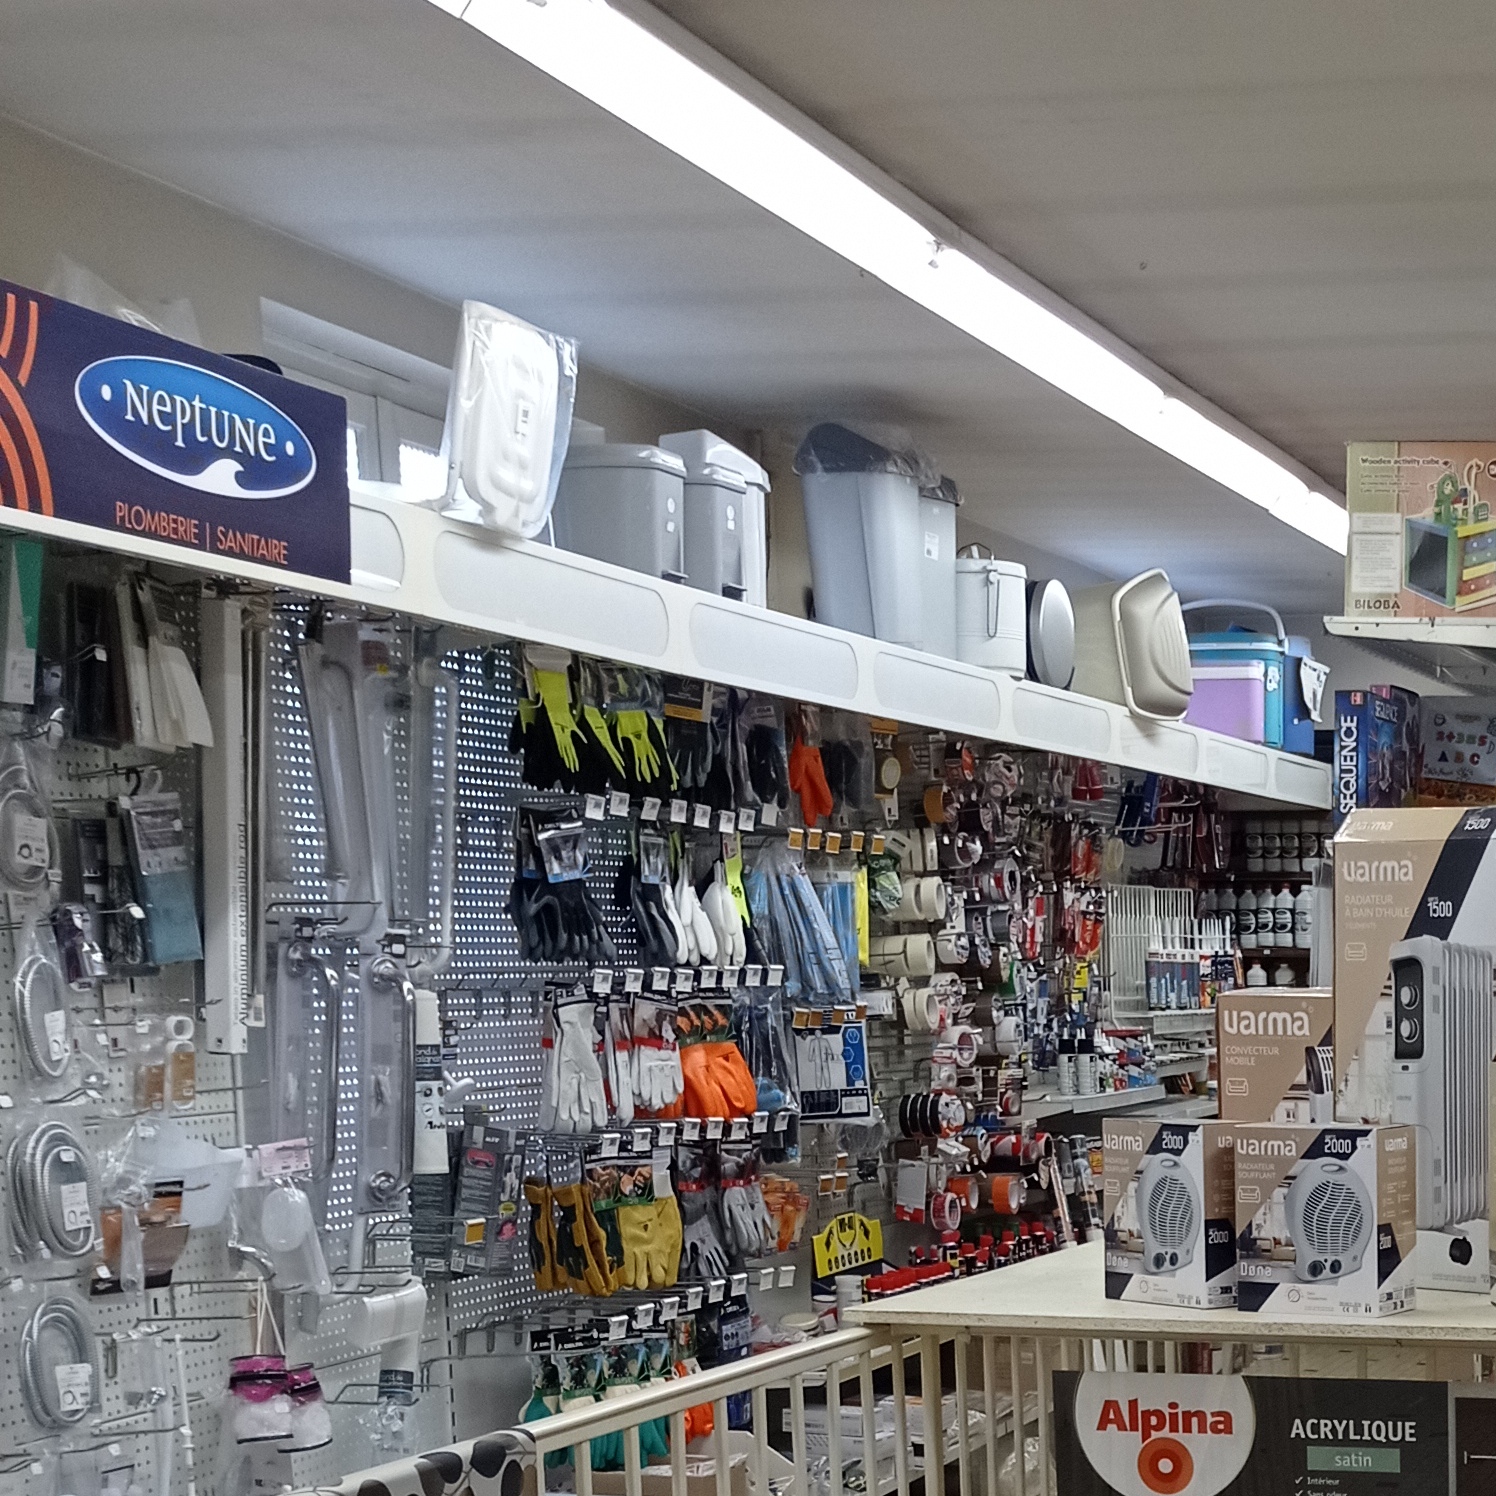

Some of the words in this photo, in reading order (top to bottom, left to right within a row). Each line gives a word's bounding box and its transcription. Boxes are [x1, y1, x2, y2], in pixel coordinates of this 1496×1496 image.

[122, 378, 277, 462] Neptune
[115, 501, 199, 545] PLOMBERIE
[216, 526, 289, 565] SANITAIRE
[1354, 598, 1401, 610] BILOBA
[1340, 715, 1358, 814] SEQUENCE
[1464, 817, 1491, 831] 1500
[237, 823, 247, 850] rod
[237, 854, 248, 938] extensible
[1344, 895, 1394, 905] RADIATEUR
[1352, 907, 1373, 918] BAIN
[1427, 901, 1453, 918] 1500
[239, 944, 248, 1026] Aluminium
[1225, 1046, 1280, 1056] CONVECTEUR
[1225, 1057, 1256, 1066] MOBILE
[1162, 1135, 1184, 1150] 2000
[1324, 1138, 1352, 1154] 2000
[1238, 1163, 1275, 1171] RADIATEUR
[1238, 1171, 1276, 1179] SOUFFLANT
[1208, 1231, 1229, 1244] 2000
[1096, 1397, 1234, 1445] Alpina
[1290, 1418, 1417, 1443] ACRYLIQUE
[1334, 1452, 1373, 1468] satin
[1307, 1476, 1340, 1486] Intérieur
